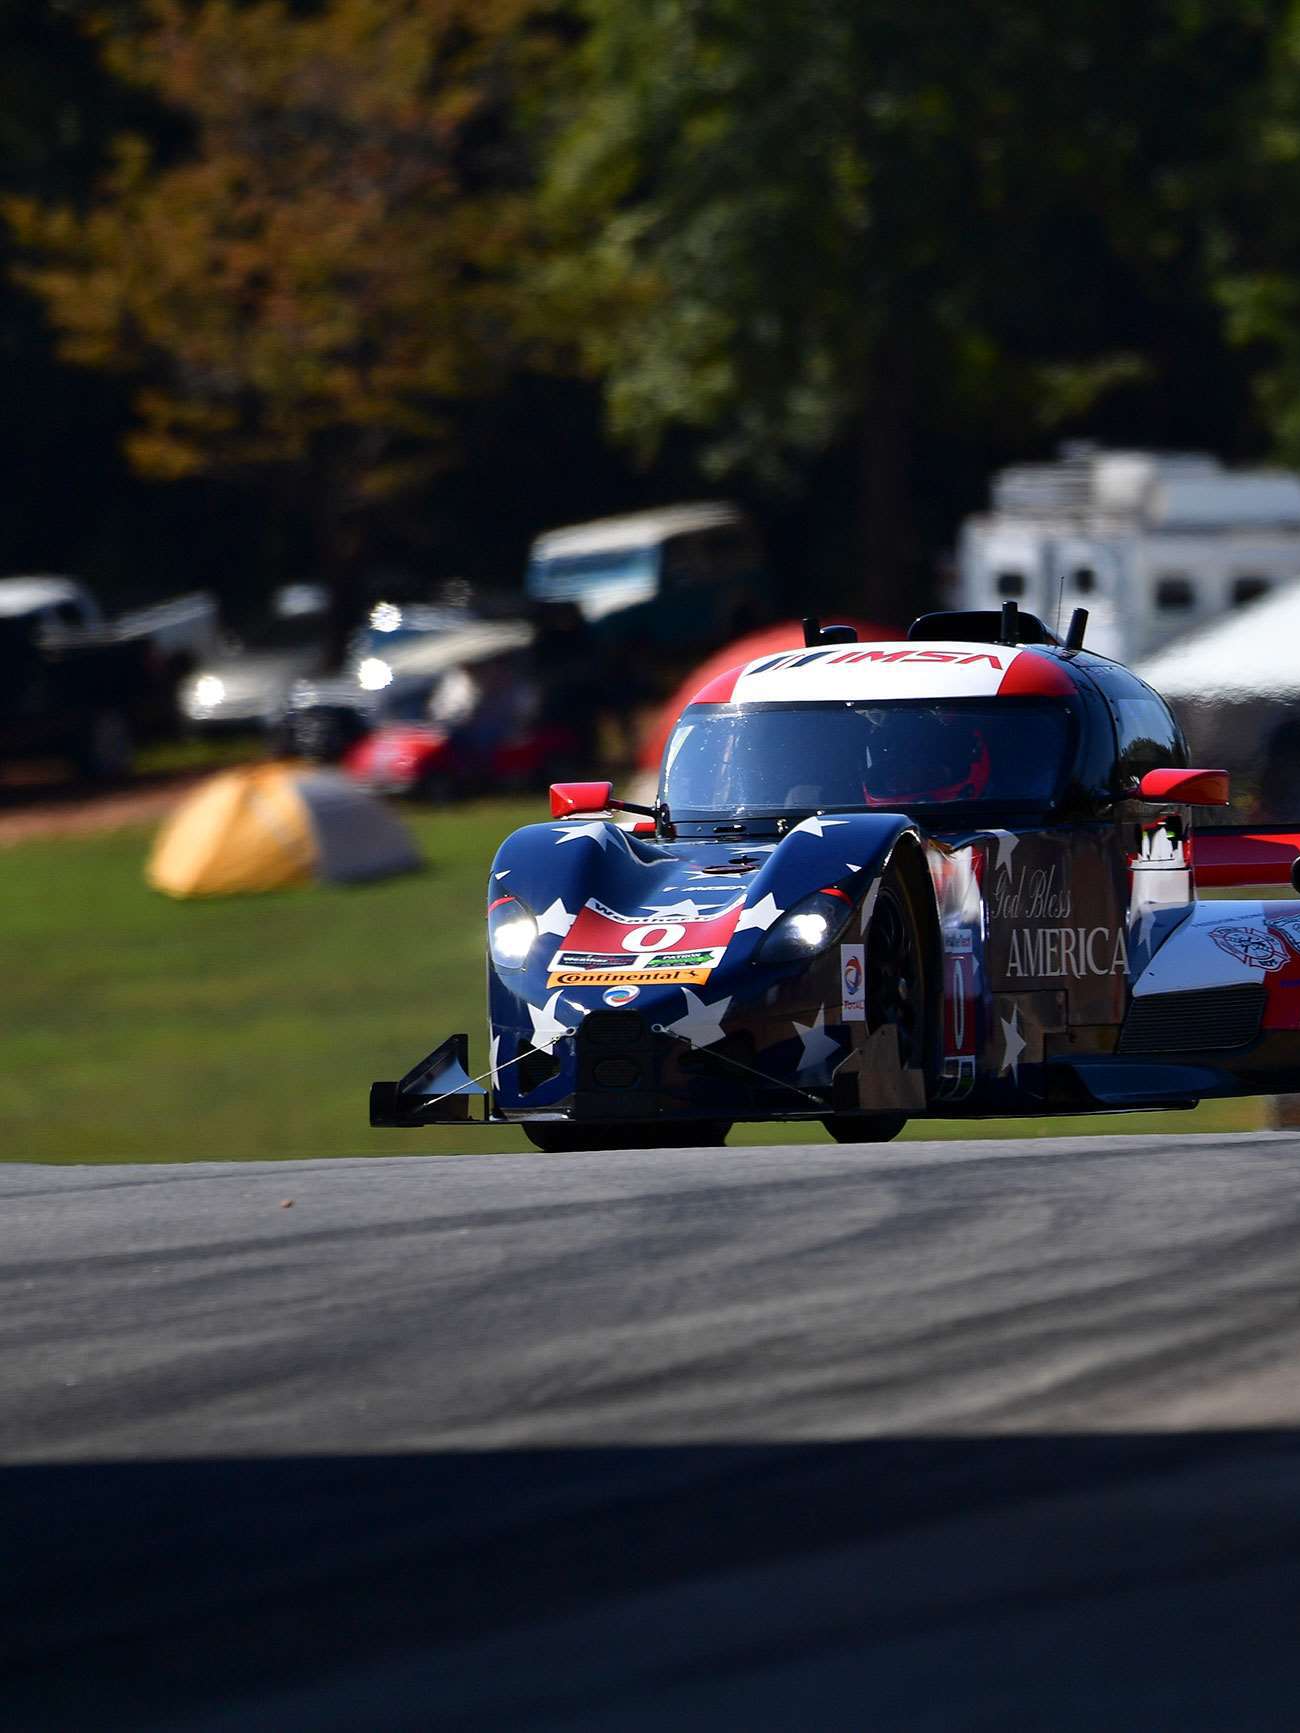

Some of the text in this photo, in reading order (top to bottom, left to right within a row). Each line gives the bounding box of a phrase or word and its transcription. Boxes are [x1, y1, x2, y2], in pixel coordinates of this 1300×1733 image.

[826, 650, 1003, 671] IMSA
[991, 864, 1072, 919] God Bless
[621, 924, 686, 952] 0
[1006, 927, 1131, 979] AMERICA
[556, 971, 680, 984] Continental
